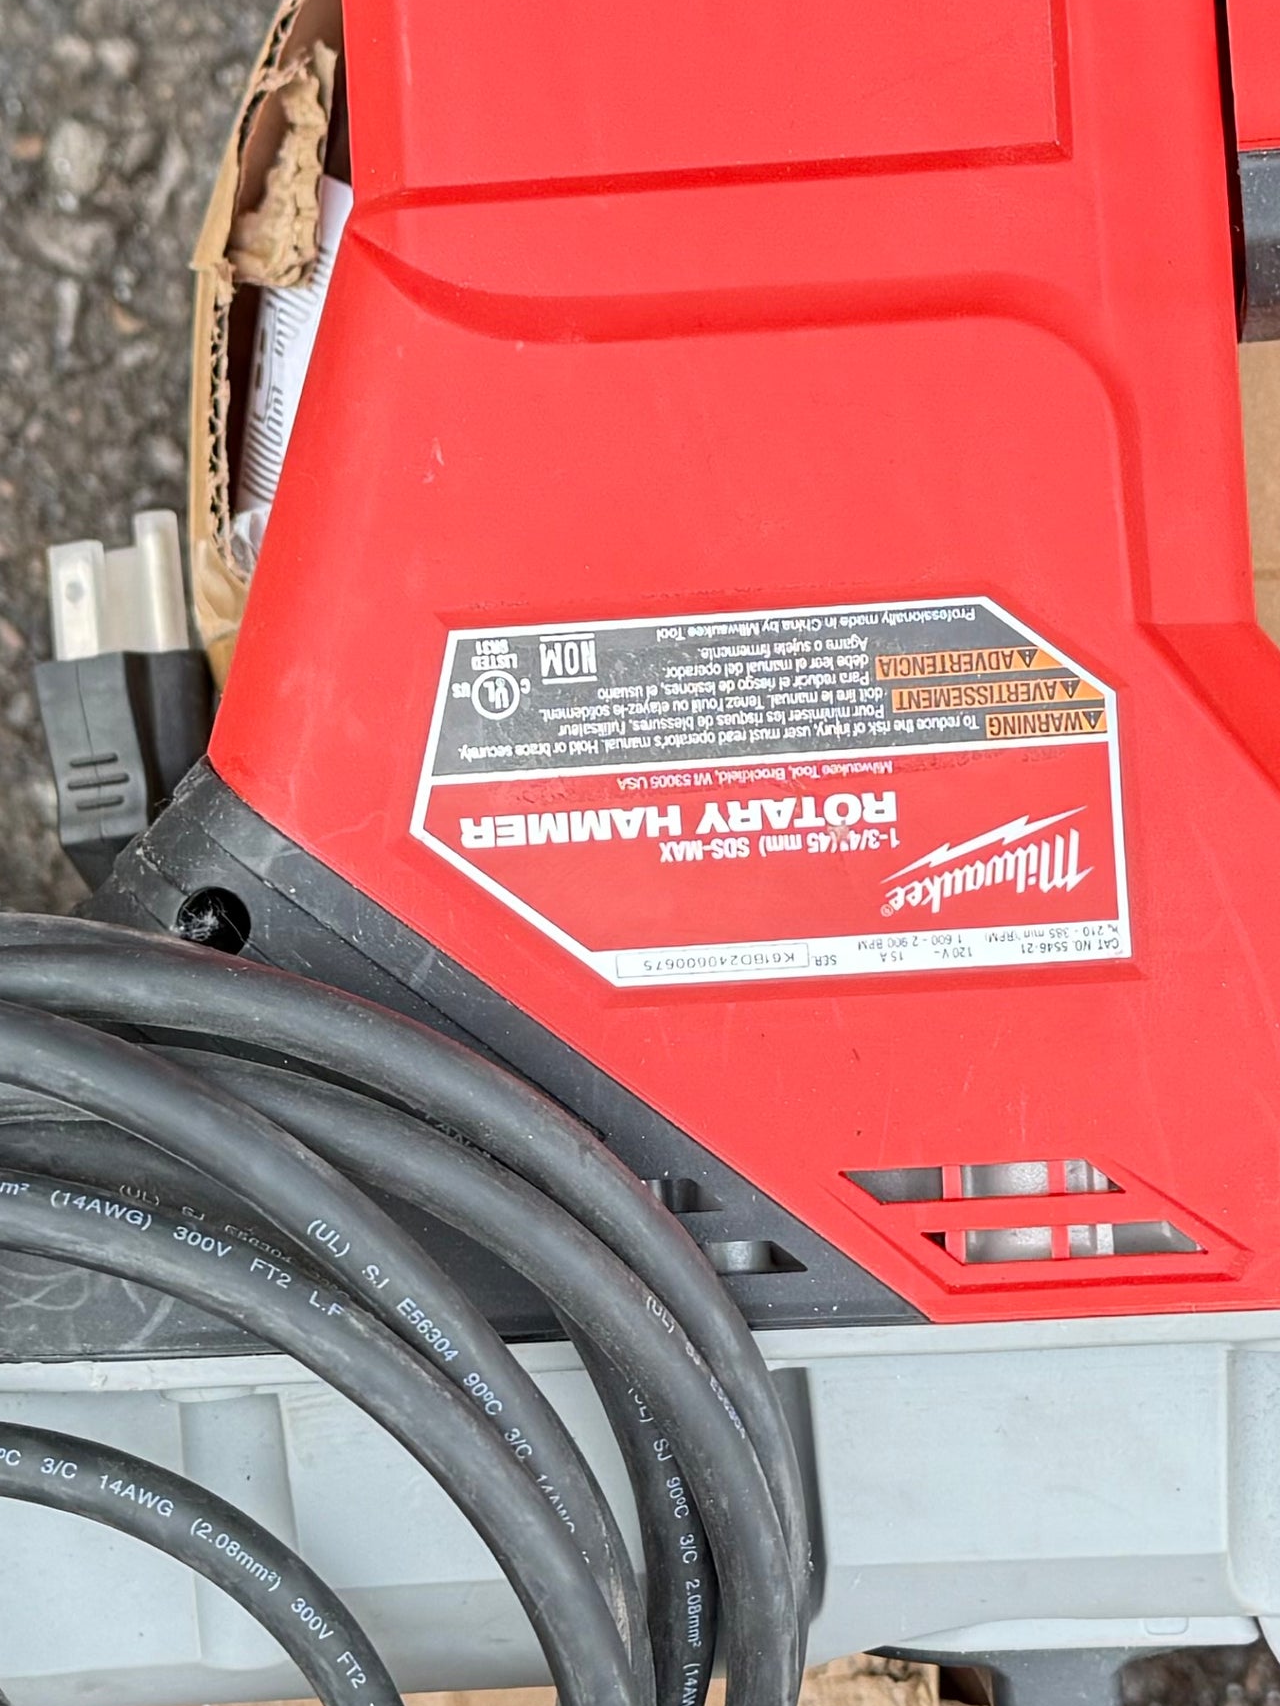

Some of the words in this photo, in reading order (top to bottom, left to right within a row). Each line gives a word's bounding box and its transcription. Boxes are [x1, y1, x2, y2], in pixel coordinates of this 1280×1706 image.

[824, 616, 837, 631] in
[839, 614, 879, 628] made
[882, 607, 976, 626] Professionally
[687, 622, 759, 639] Milwaukee
[761, 618, 779, 636] by
[781, 618, 822, 633] China
[656, 628, 686, 642] Tool
[813, 640, 823, 652] o
[471, 652, 518, 670] LISTED
[539, 639, 597, 677] NOM
[795, 658, 807, 672] el
[836, 653, 870, 669] debe
[878, 650, 1014, 677] ADVERTENCIA
[724, 662, 744, 677] del
[746, 658, 793, 676] manual
[779, 675, 791, 690] el
[793, 673, 836, 689] reducir
[838, 670, 870, 686] Para
[646, 685, 658, 698] el
[719, 680, 735, 694] de
[821, 690, 834, 704] le
[836, 688, 856, 704] lire
[858, 687, 883, 703] doit
[895, 681, 1058, 711] AVERTISSEMENT
[672, 699, 689, 712] ou
[852, 703, 885, 719] Pour
[697, 715, 713, 730] de
[715, 710, 764, 727] risques
[766, 710, 786, 725] les
[916, 716, 960, 732] reduce
[962, 714, 979, 730] To
[988, 713, 1083, 737] WARNING
[783, 725, 811, 738] user
[853, 723, 866, 737] of
[867, 720, 891, 735] risk
[892, 719, 914, 733] the
[718, 730, 747, 745] read
[749, 728, 781, 743] must
[514, 743, 551, 757] brace
[553, 742, 567, 754] or
[568, 739, 599, 755] Hold
[602, 736, 651, 754] manual.
[788, 765, 820, 780] Tool,
[821, 760, 893, 776] Milwaukee
[616, 777, 648, 790] USA
[694, 772, 712, 786] WI
[695, 791, 898, 835] ROTARY
[459, 805, 682, 850] HAMMER
[660, 837, 750, 863] SDS-MAX
[758, 833, 802, 857] mm)
[1048, 927, 1069, 939] 385
[1082, 925, 1104, 936] 210
[858, 938, 883, 950] BPM
[1020, 940, 1068, 954] 5546-21
[1072, 939, 1092, 952] NO.
[1097, 938, 1119, 951] CAT
[879, 951, 888, 963] A
[890, 950, 903, 962] 15
[952, 946, 972, 959] 120
[50, 1188, 153, 1231] (14AWG)
[172, 1225, 234, 1258] 300V
[249, 1257, 293, 1290] FT2
[308, 1289, 345, 1318] L.F
[306, 1219, 351, 1258] (UL)
[361, 1264, 390, 1290] SJ
[396, 1297, 460, 1362] E56304
[504, 1428, 533, 1460] 3/C
[653, 1437, 673, 1462] SJ
[679, 1533, 698, 1565] 3/C
[40, 1457, 78, 1480] 3/C
[98, 1474, 174, 1518] 14AWG
[190, 1517, 282, 1592] (2.08mm²)
[290, 1597, 334, 1641] 300V
[336, 1650, 367, 1689] FT2
